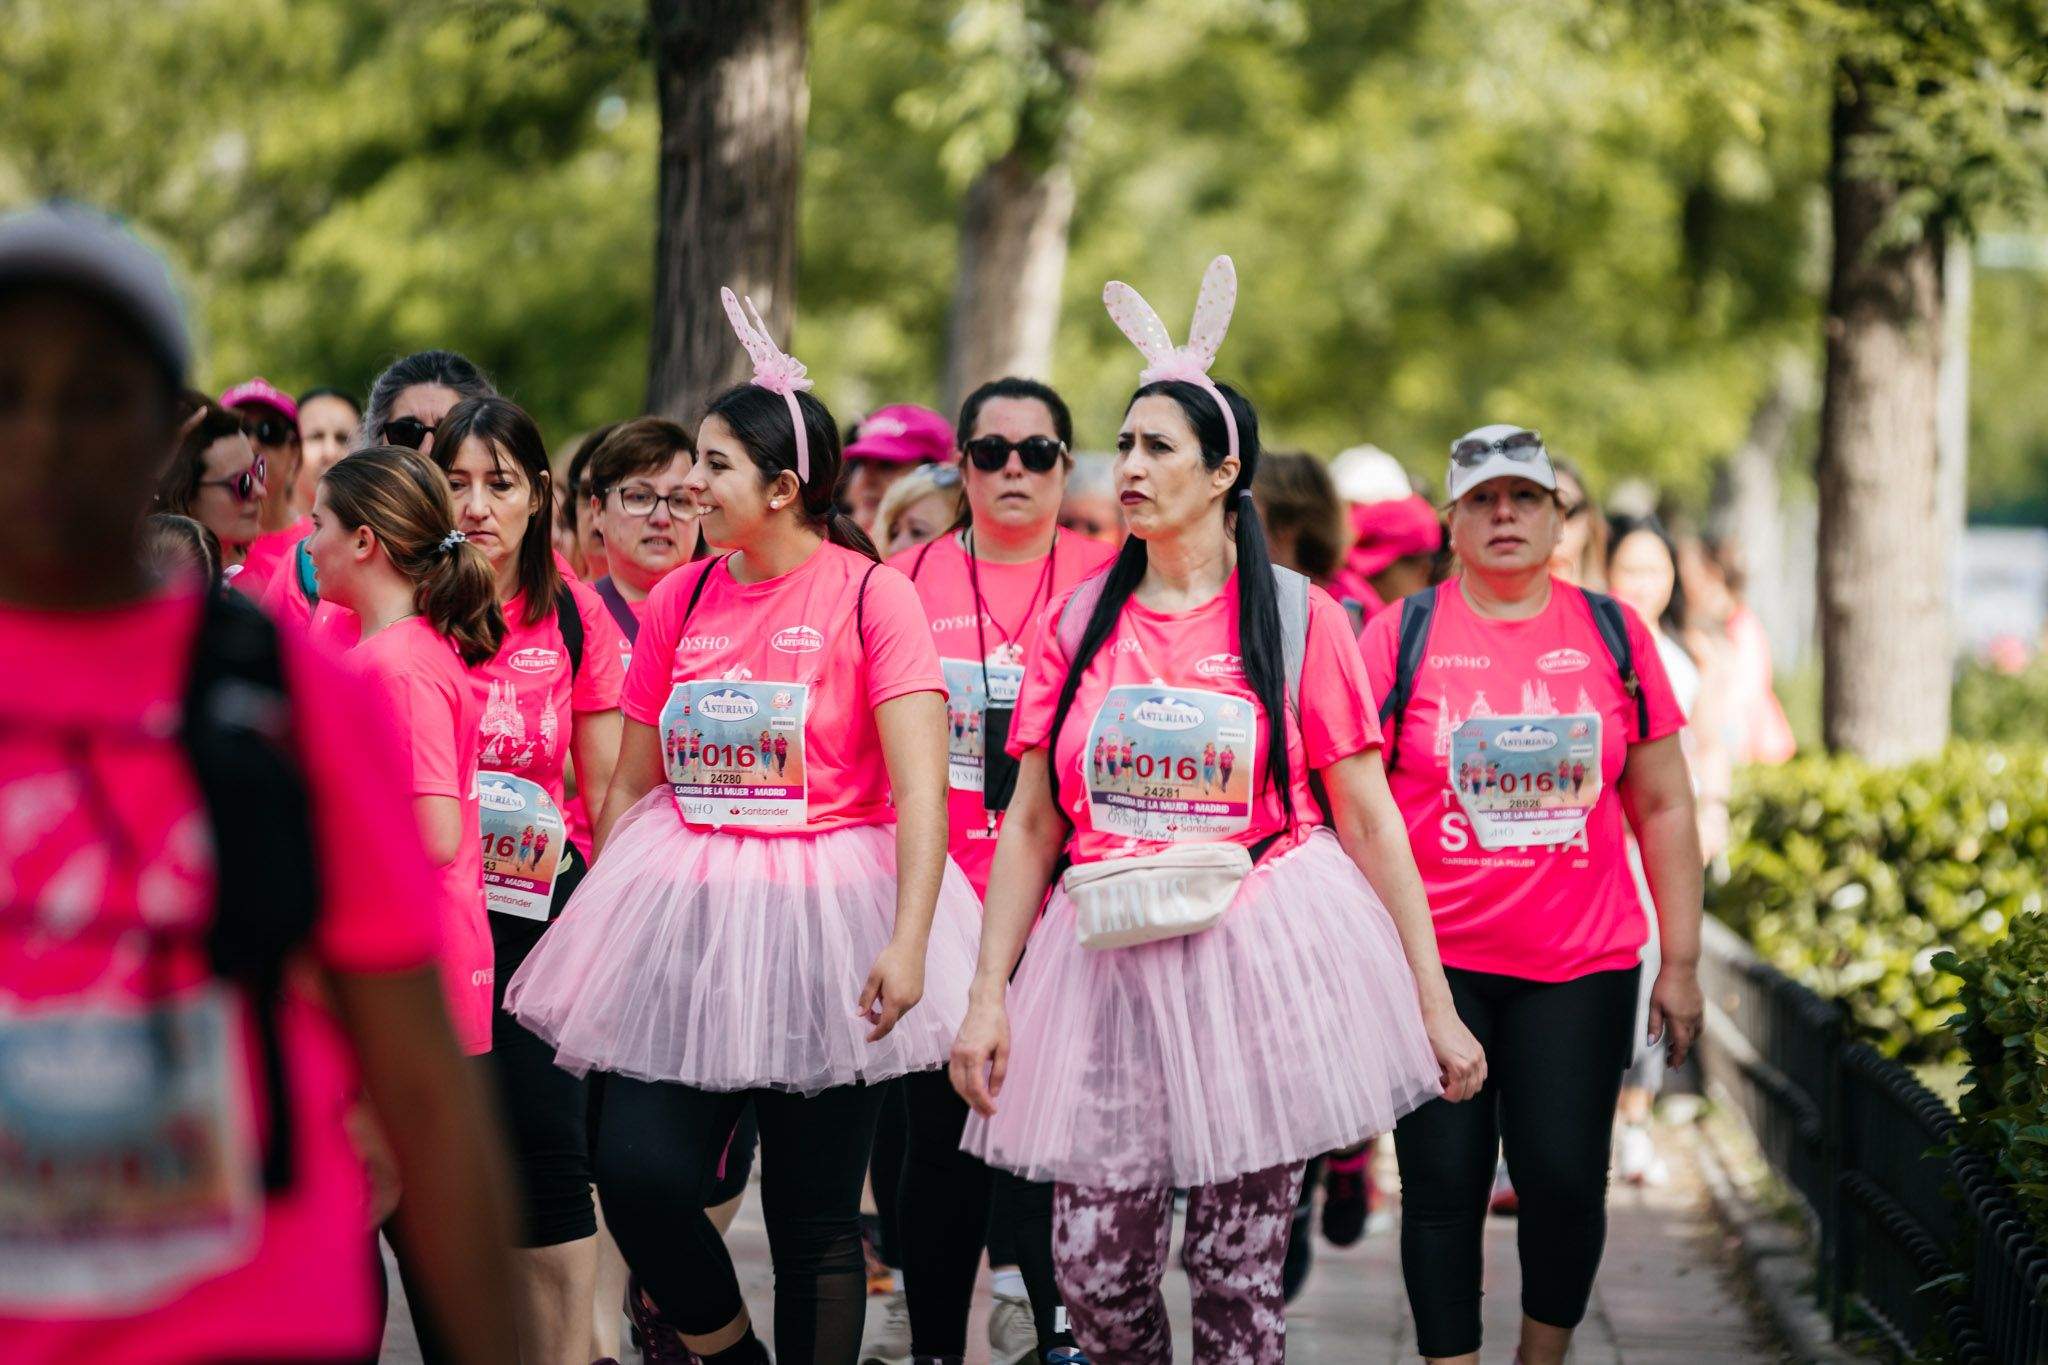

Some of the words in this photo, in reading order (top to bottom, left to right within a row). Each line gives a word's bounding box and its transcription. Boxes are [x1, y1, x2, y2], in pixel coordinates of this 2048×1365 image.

[1430, 655, 1491, 669] OYSHO
[702, 701, 754, 714] ASTURIANA
[1138, 708, 1198, 724] ASTURIANA
[1499, 735, 1554, 748] ASTURIANA
[702, 744, 756, 768] 016
[1136, 754, 1198, 781] 016
[711, 773, 742, 784] 24280
[1500, 772, 1554, 794] 016
[674, 785, 702, 795] CARRERA
[703, 786, 715, 796] DE
[715, 787, 723, 796] LA
[724, 787, 749, 796] MUJER
[754, 787, 787, 797] MADRID
[1144, 786, 1180, 798] 24281
[480, 790, 522, 808] STURIANA
[681, 803, 713, 816] YSHO
[741, 806, 789, 816] Santander
[1136, 799, 1147, 809] DE
[1148, 800, 1158, 810] LA
[1160, 801, 1189, 812] MUJER
[1194, 802, 1230, 814] MADRID
[1503, 811, 1514, 821] DE
[1514, 810, 1525, 820] LA
[1525, 810, 1549, 819] MUJER
[1181, 823, 1231, 834] Santander
[482, 832, 516, 858] 16
[1441, 857, 1480, 866] CARRERA
[1480, 858, 1493, 867] DE
[1493, 858, 1504, 867] LA
[1505, 858, 1536, 868] MUJER
[484, 873, 500, 883] UJER
[504, 876, 535, 889] MADRID
[487, 892, 533, 908] Santander
